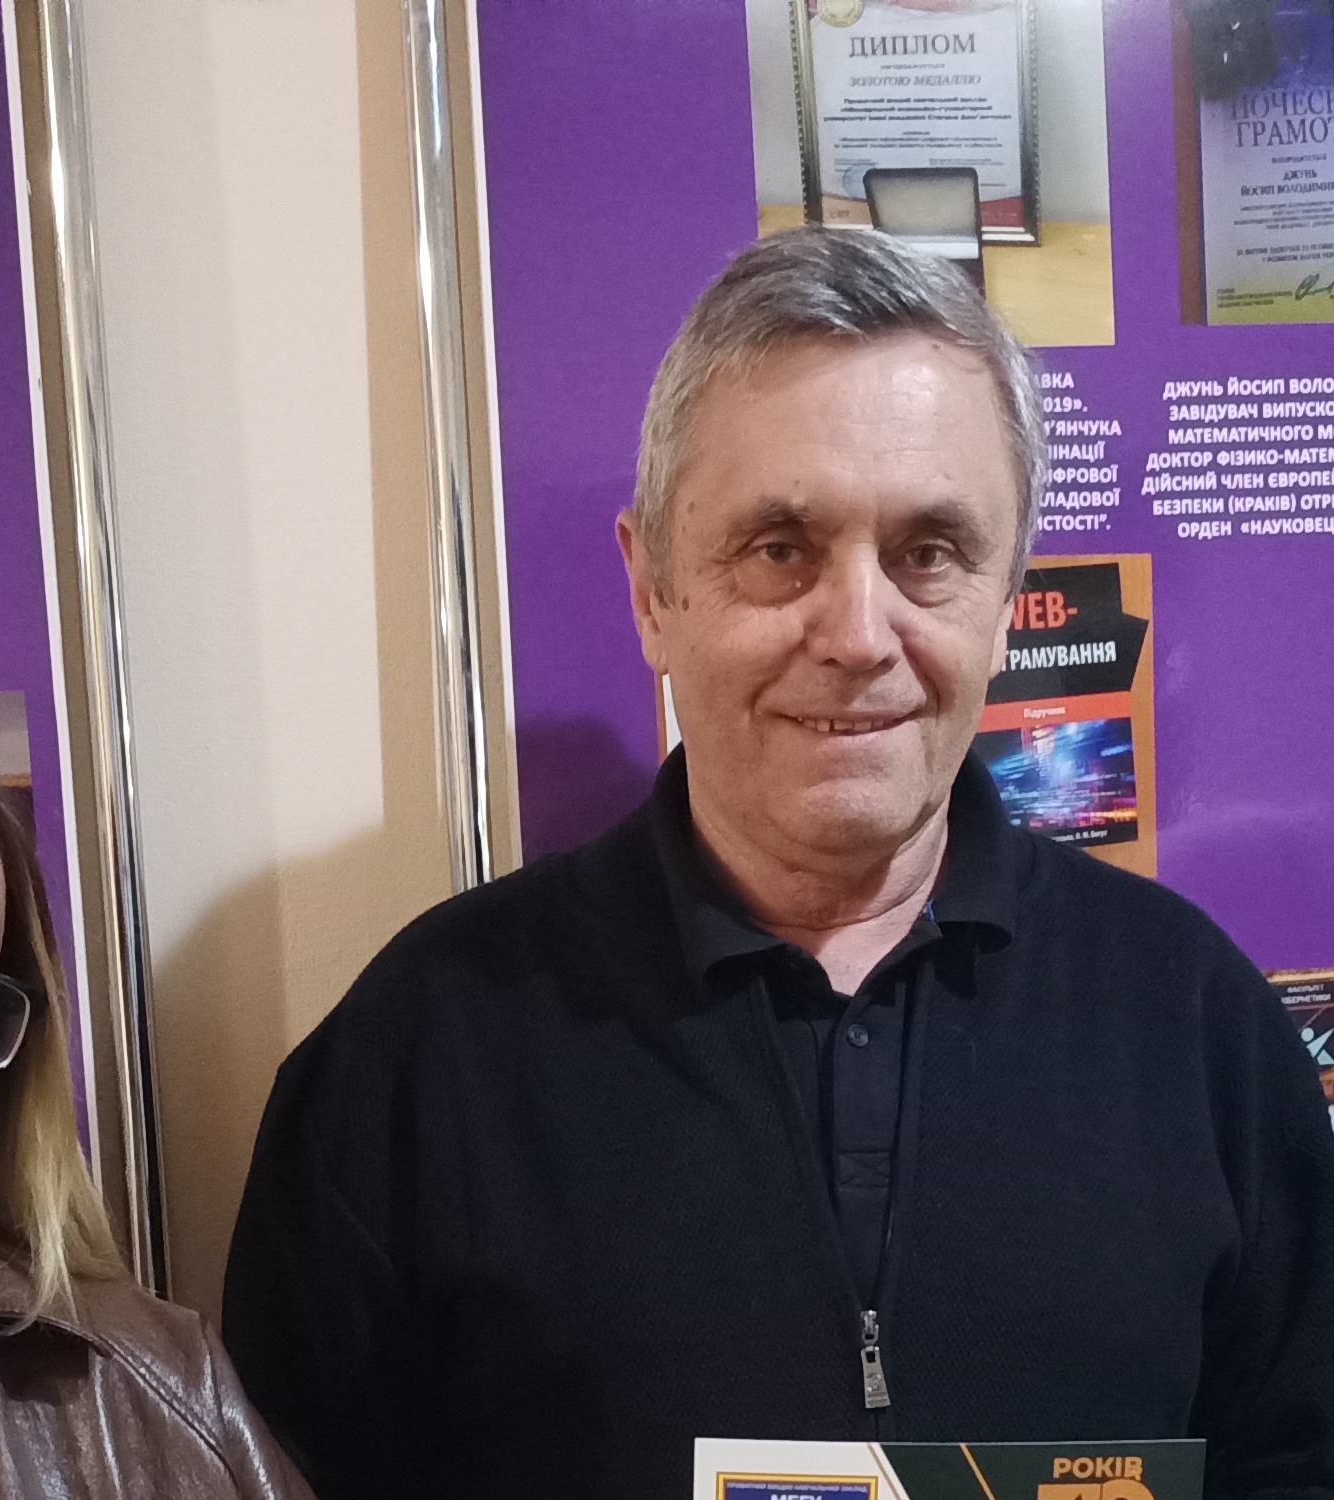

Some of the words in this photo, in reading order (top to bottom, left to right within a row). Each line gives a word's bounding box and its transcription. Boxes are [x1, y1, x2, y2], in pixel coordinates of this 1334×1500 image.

[848, 33, 976, 57] ДИПЛОМ
[1163, 381, 1223, 400] ДЖУНЬ
[1228, 377, 1285, 396] ЙОСИП
[1169, 402, 1258, 422] ЗАВІДУВАЧ
[1168, 425, 1313, 444] МАТЕМАТИЧНОГО
[1146, 451, 1212, 471] ДОКТОР
[1141, 471, 1217, 495] ДІЙСНИЙ
[1221, 473, 1264, 490] ЧЛЕН
[1153, 497, 1224, 515] БЕЗПЕКИ
[1228, 493, 1296, 515] (КРАКІВ)
[1178, 521, 1231, 539] ОРДЕН
[1053, 1456, 1143, 1480] РОКІВ
